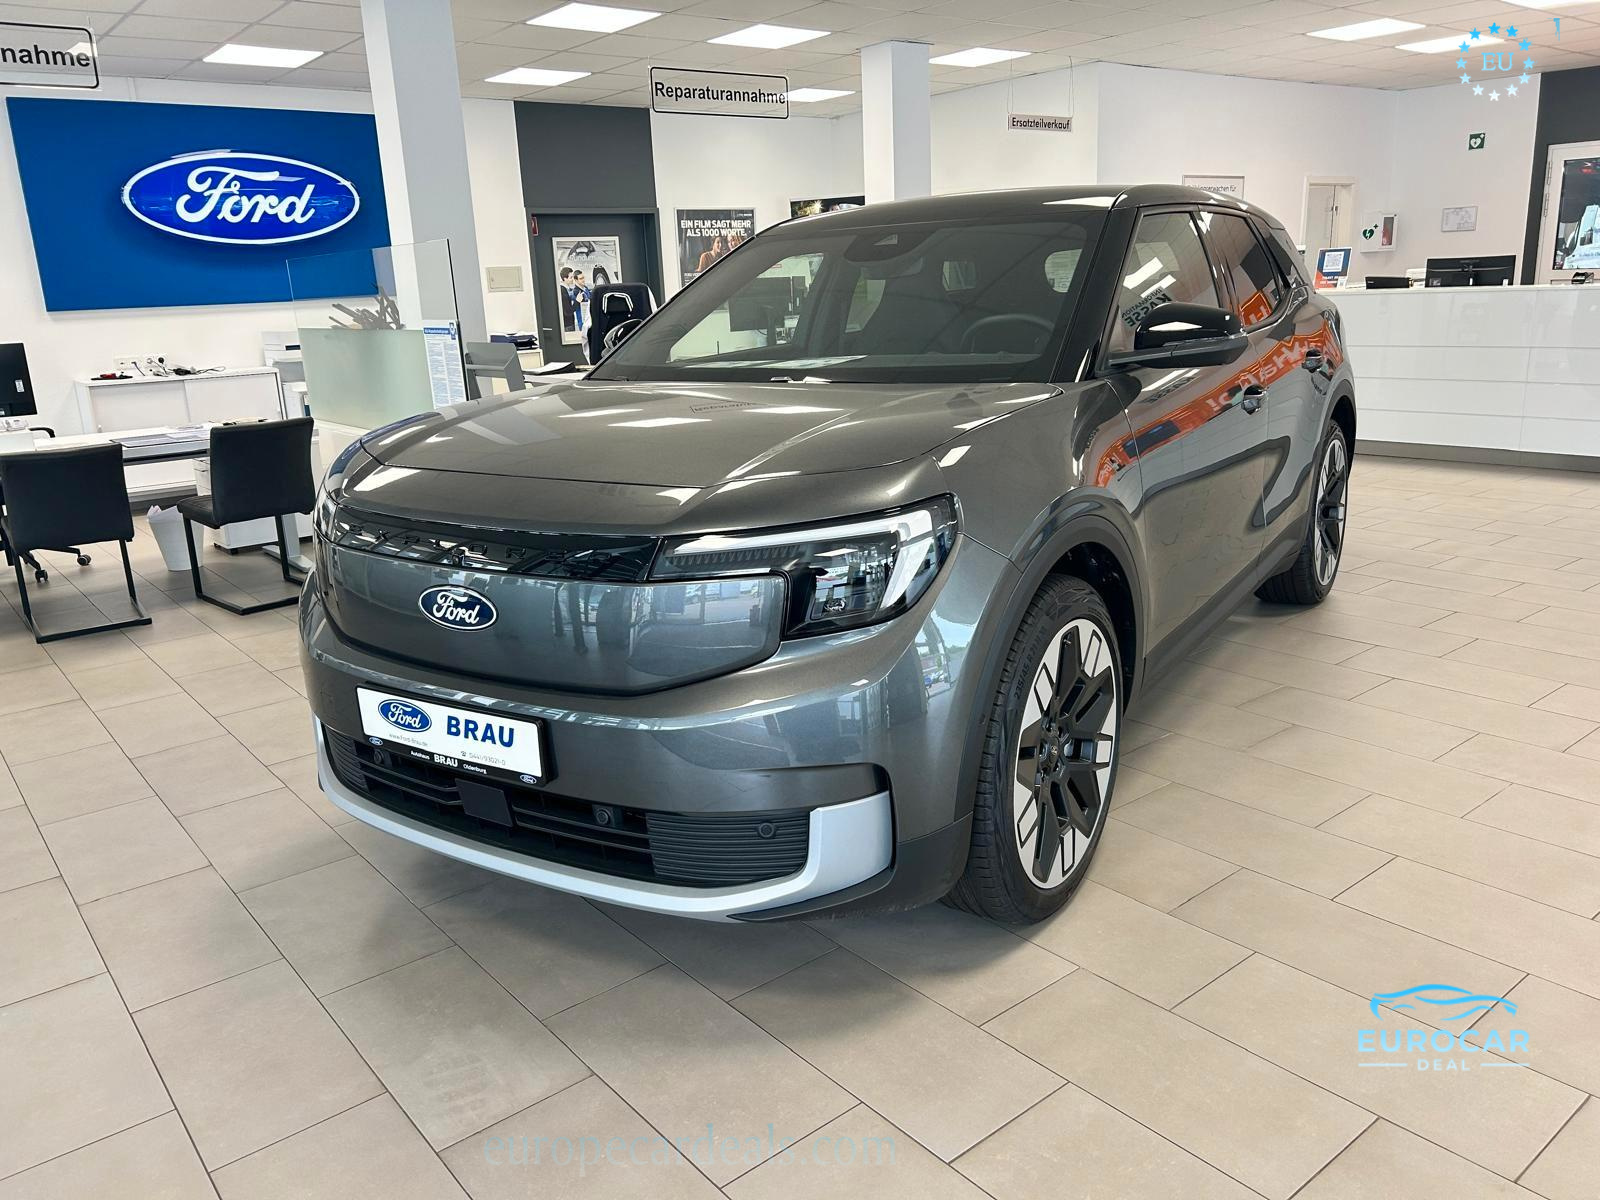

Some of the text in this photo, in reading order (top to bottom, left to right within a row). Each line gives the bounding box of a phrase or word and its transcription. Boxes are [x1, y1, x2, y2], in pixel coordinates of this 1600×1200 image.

[654, 82, 786, 104] Reparaturannahme
[1012, 117, 1070, 129] Ersatzteilverkauf
[175, 165, 316, 224] Ford
[680, 219, 751, 228] EIN FILM SAGT MEHR
[686, 228, 747, 237] ALS 1000 WORTE.
[432, 591, 480, 624] Ford
[387, 702, 515, 748] Ford BRAU
[433, 754, 459, 768] BRAU
